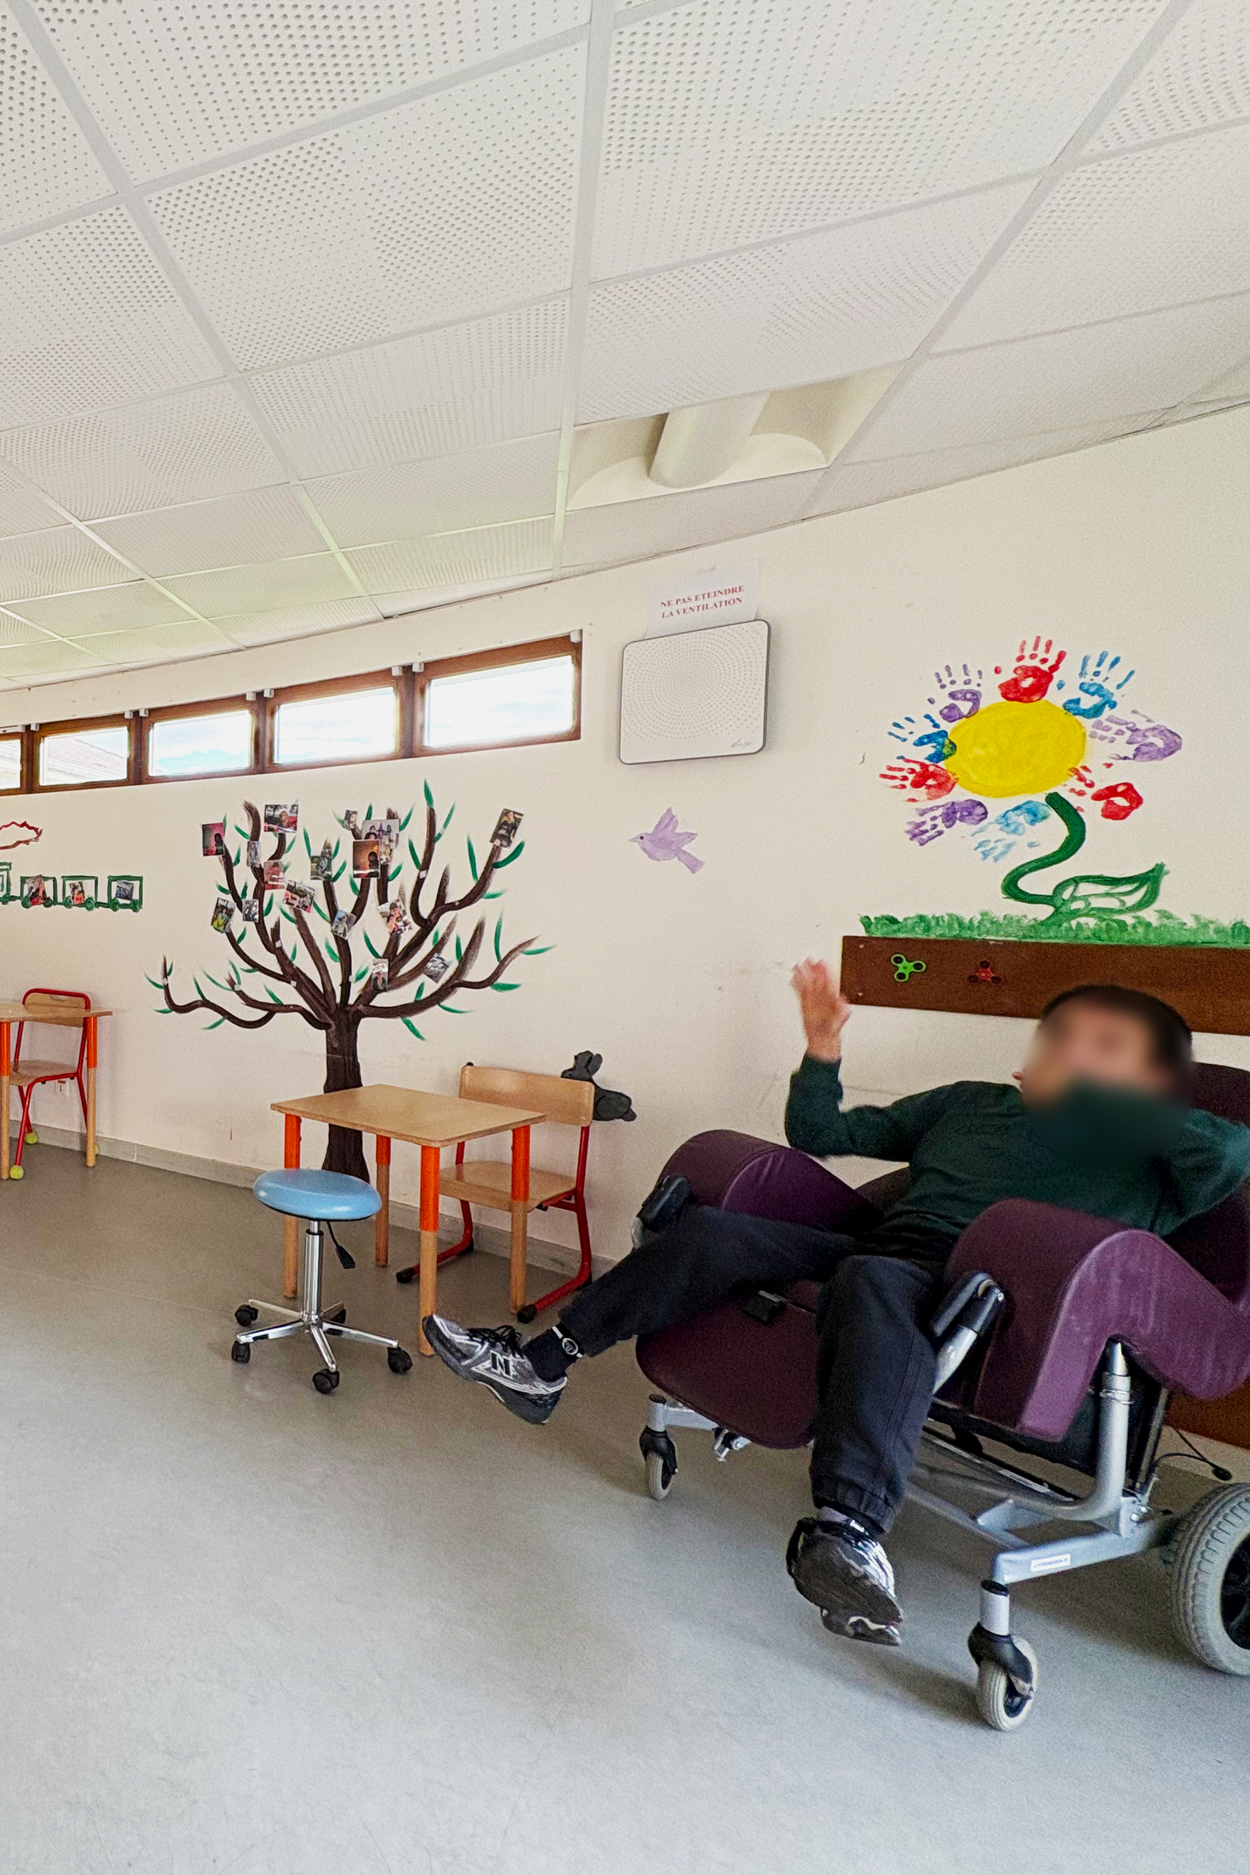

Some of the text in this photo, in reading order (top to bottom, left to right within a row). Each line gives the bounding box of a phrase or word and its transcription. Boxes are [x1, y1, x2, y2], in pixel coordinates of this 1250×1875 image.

[660, 585, 745, 609] NE PAS ETEINDRE
[661, 597, 743, 619] LA VENTILATION
